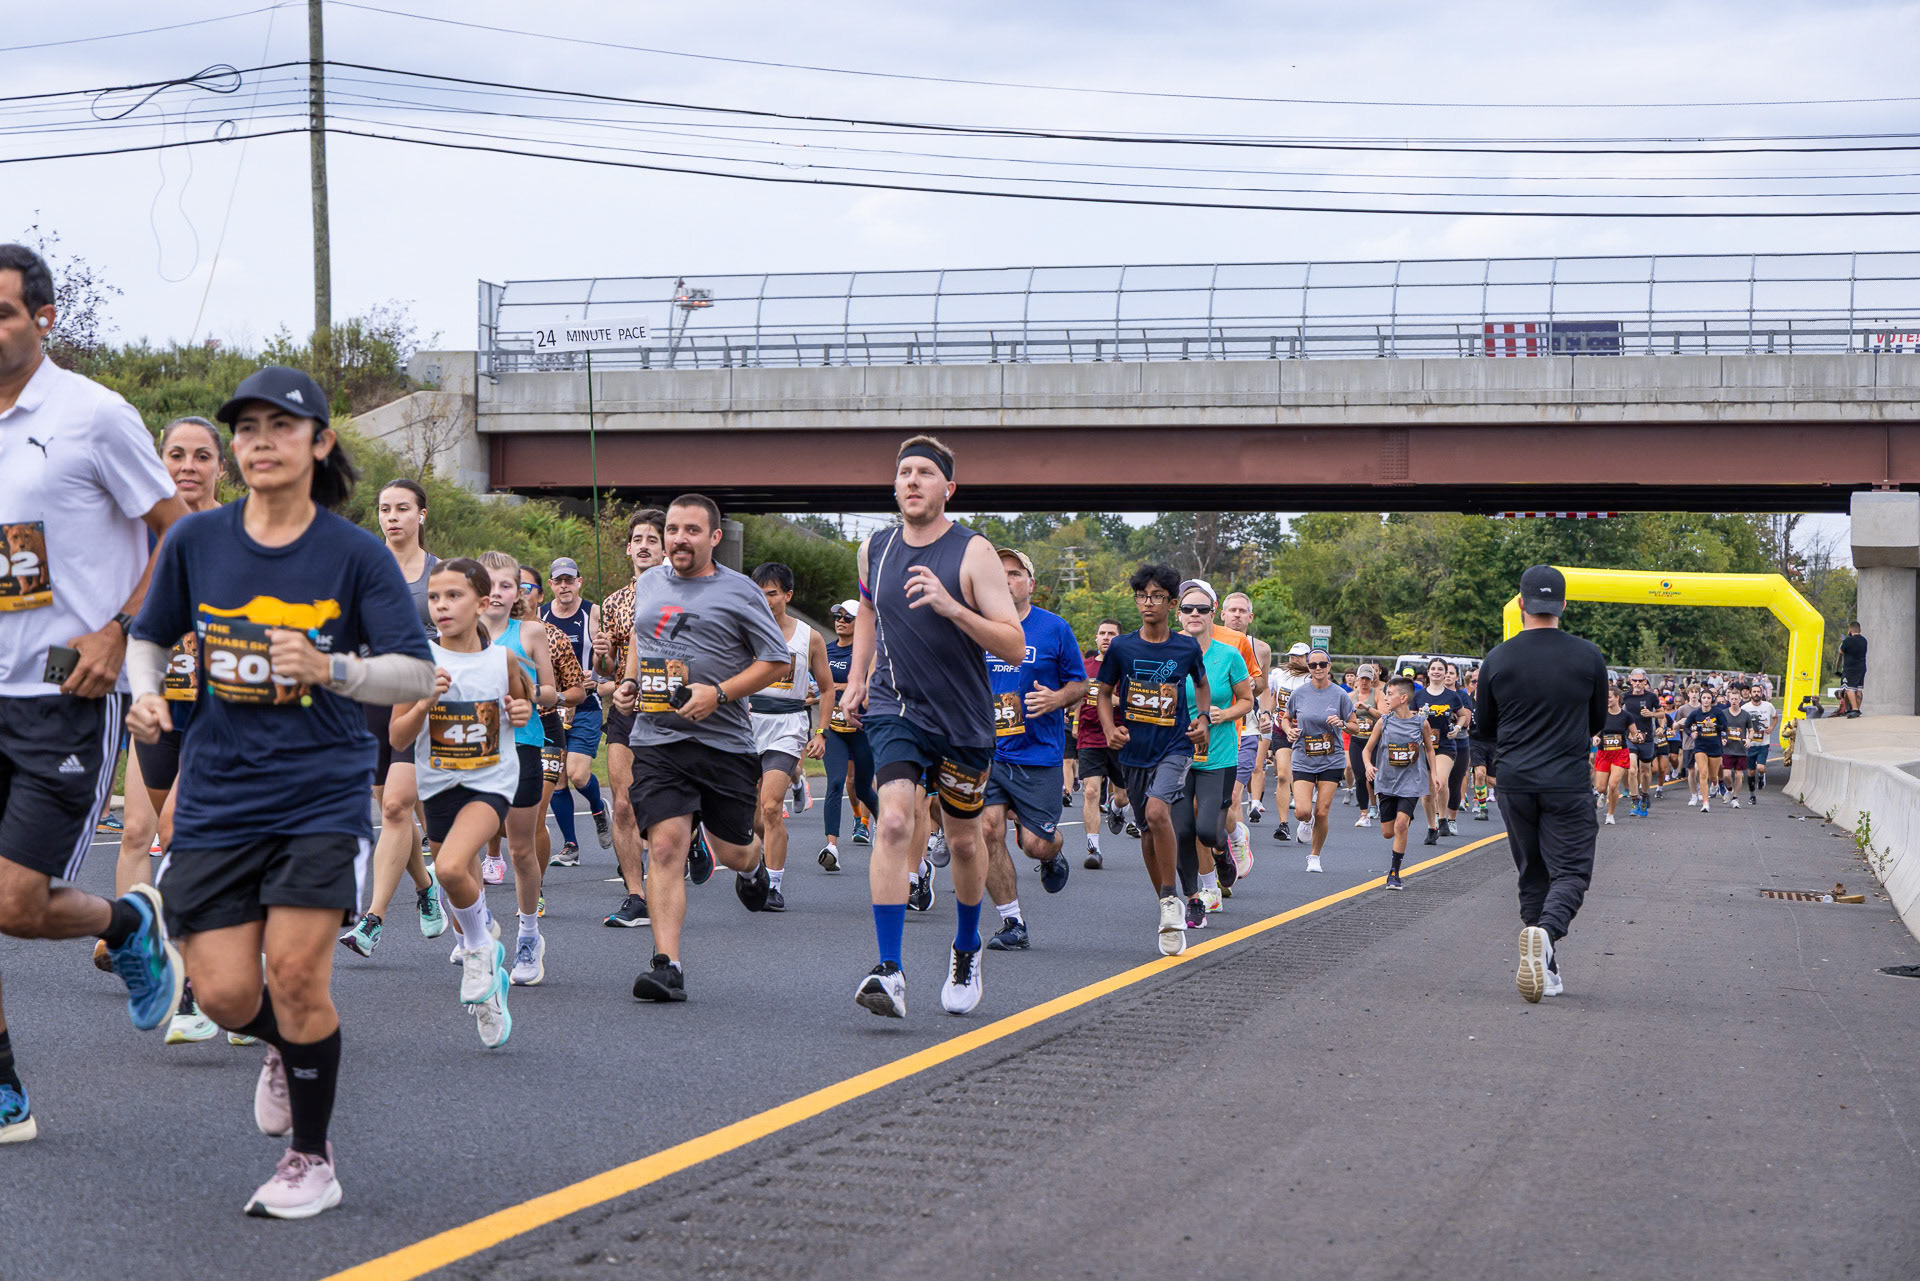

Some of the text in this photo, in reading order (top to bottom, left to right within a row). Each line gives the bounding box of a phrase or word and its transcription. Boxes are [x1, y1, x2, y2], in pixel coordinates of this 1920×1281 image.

[536, 326, 646, 347] 24 MINUTE PACE
[207, 623, 230, 634] THE
[205, 634, 248, 649] CHASE
[166, 654, 195, 674] 3
[829, 660, 847, 670] F45
[992, 664, 1014, 673] JDRF
[1131, 693, 1173, 709] 347
[443, 723, 487, 744] 42
[1308, 741, 1331, 750] 128
[1392, 751, 1415, 760] 127
